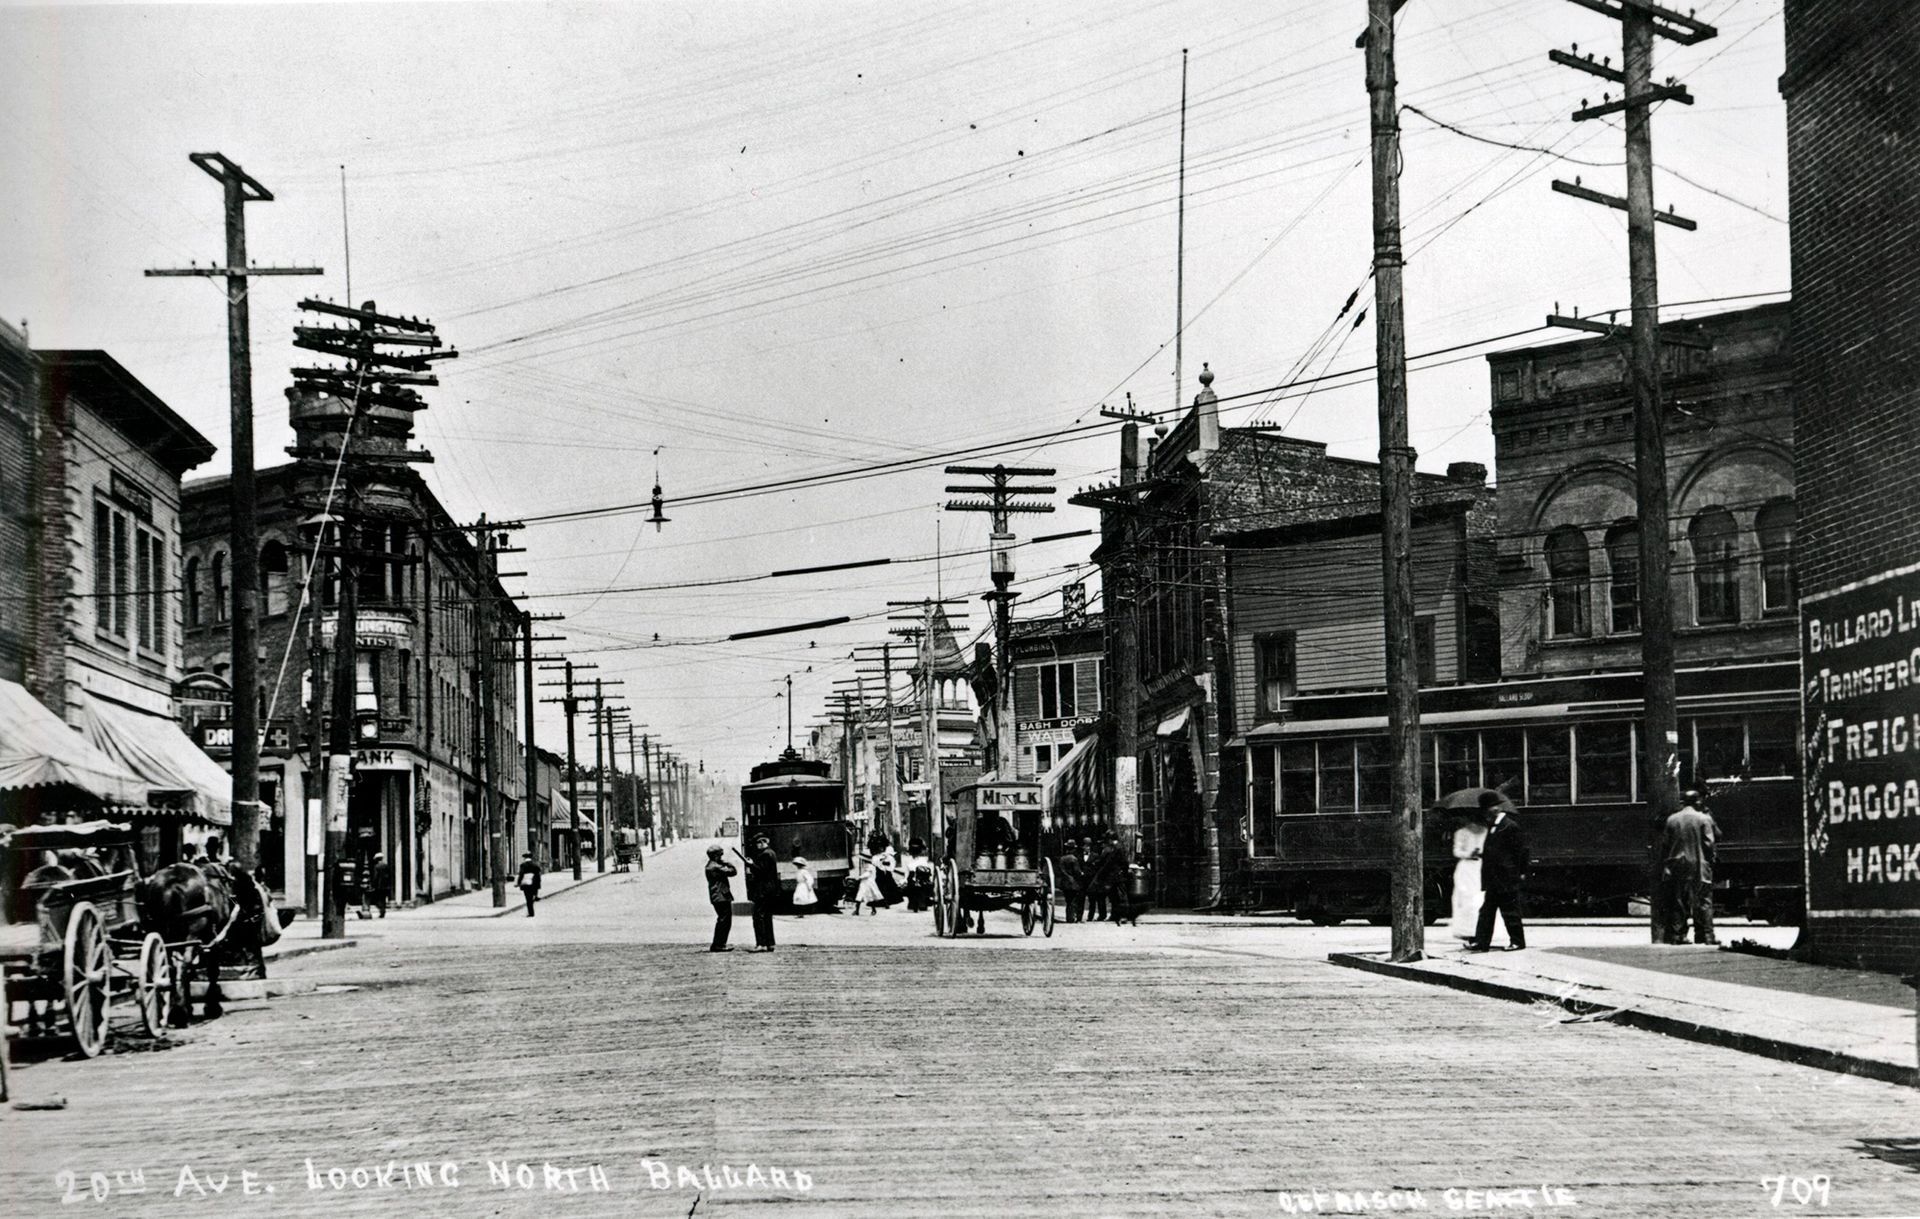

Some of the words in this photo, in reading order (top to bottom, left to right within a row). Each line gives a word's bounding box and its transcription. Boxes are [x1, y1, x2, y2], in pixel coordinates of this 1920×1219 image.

[1809, 608, 1893, 653] BALLARD
[355, 637, 394, 647] NTIST
[1820, 660, 1909, 703] TRANSFER
[1020, 721, 1051, 731] SASH
[1027, 731, 1073, 742] WALL
[357, 750, 394, 765] ANK
[983, 790, 1039, 804] MILK
